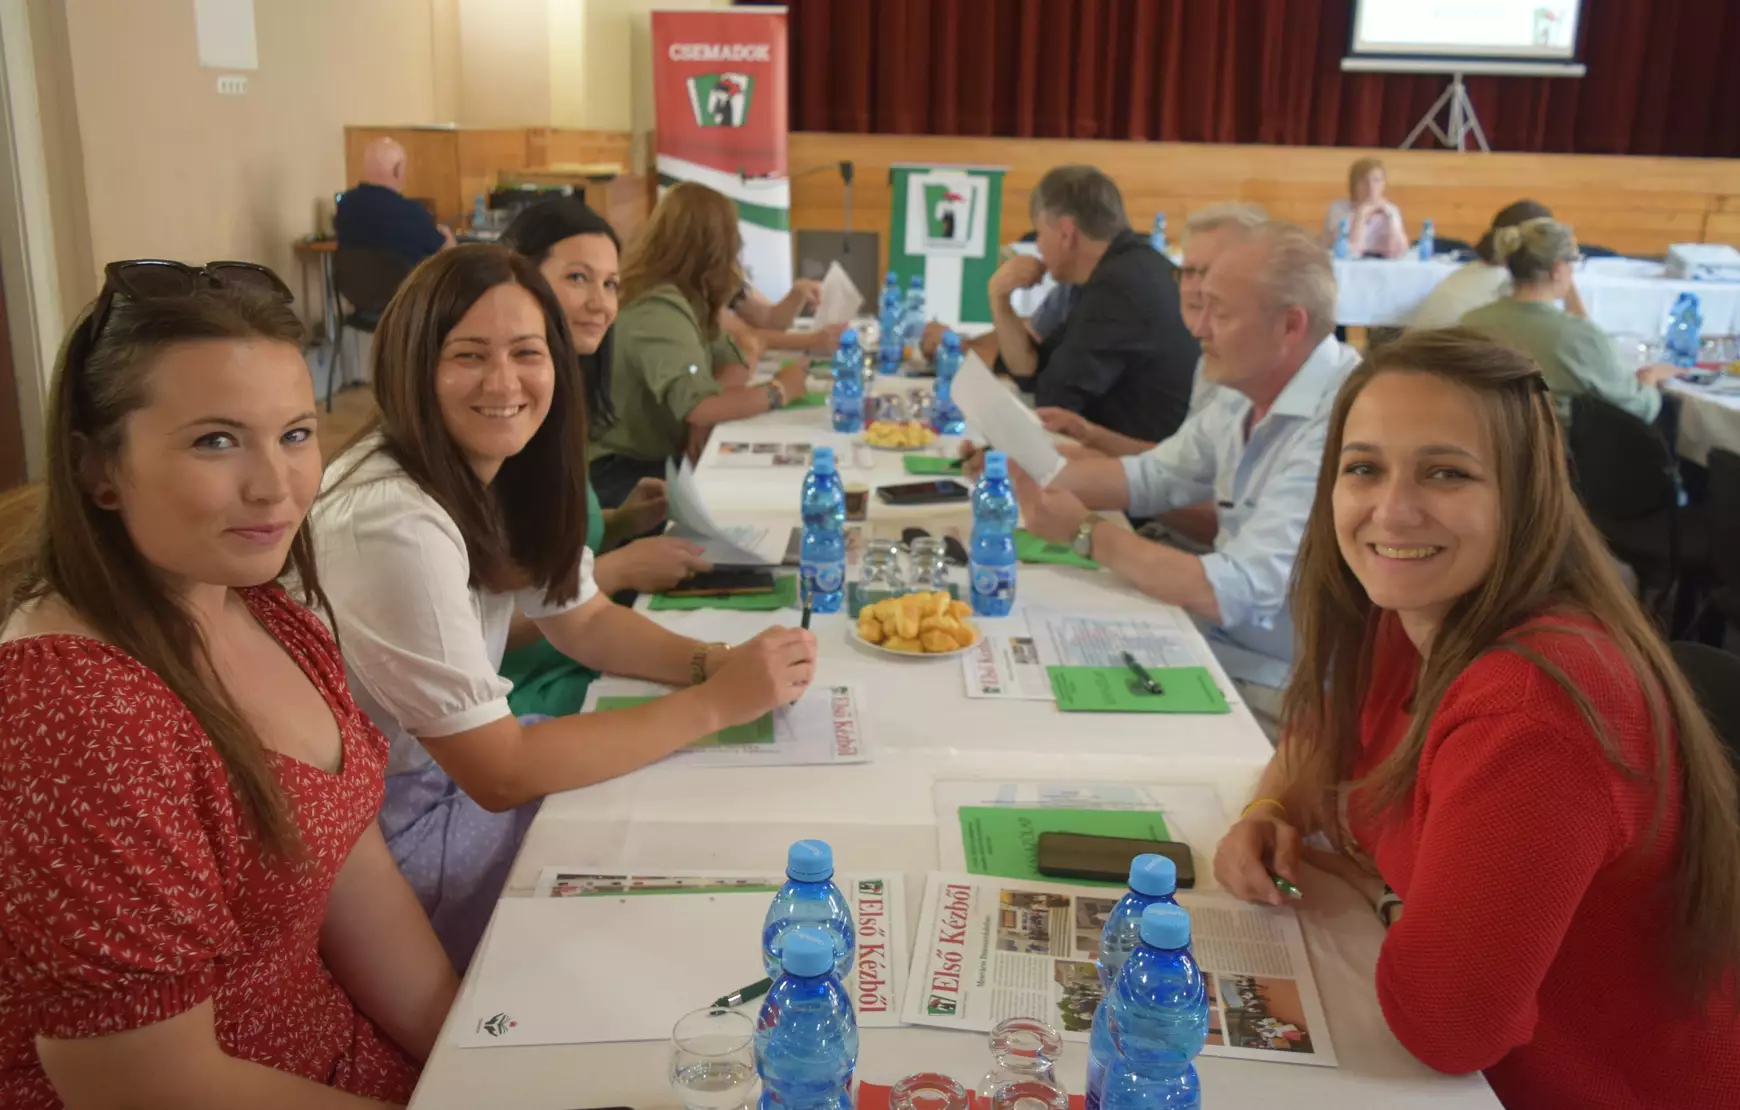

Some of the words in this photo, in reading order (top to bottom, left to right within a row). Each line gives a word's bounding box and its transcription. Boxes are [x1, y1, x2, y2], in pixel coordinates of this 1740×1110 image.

[668, 43, 770, 62] CSEMADOK
[859, 899, 885, 937] Első
[938, 884, 971, 945] Kézből
[859, 943, 887, 1012] Kézből
[931, 948, 963, 993] Első
